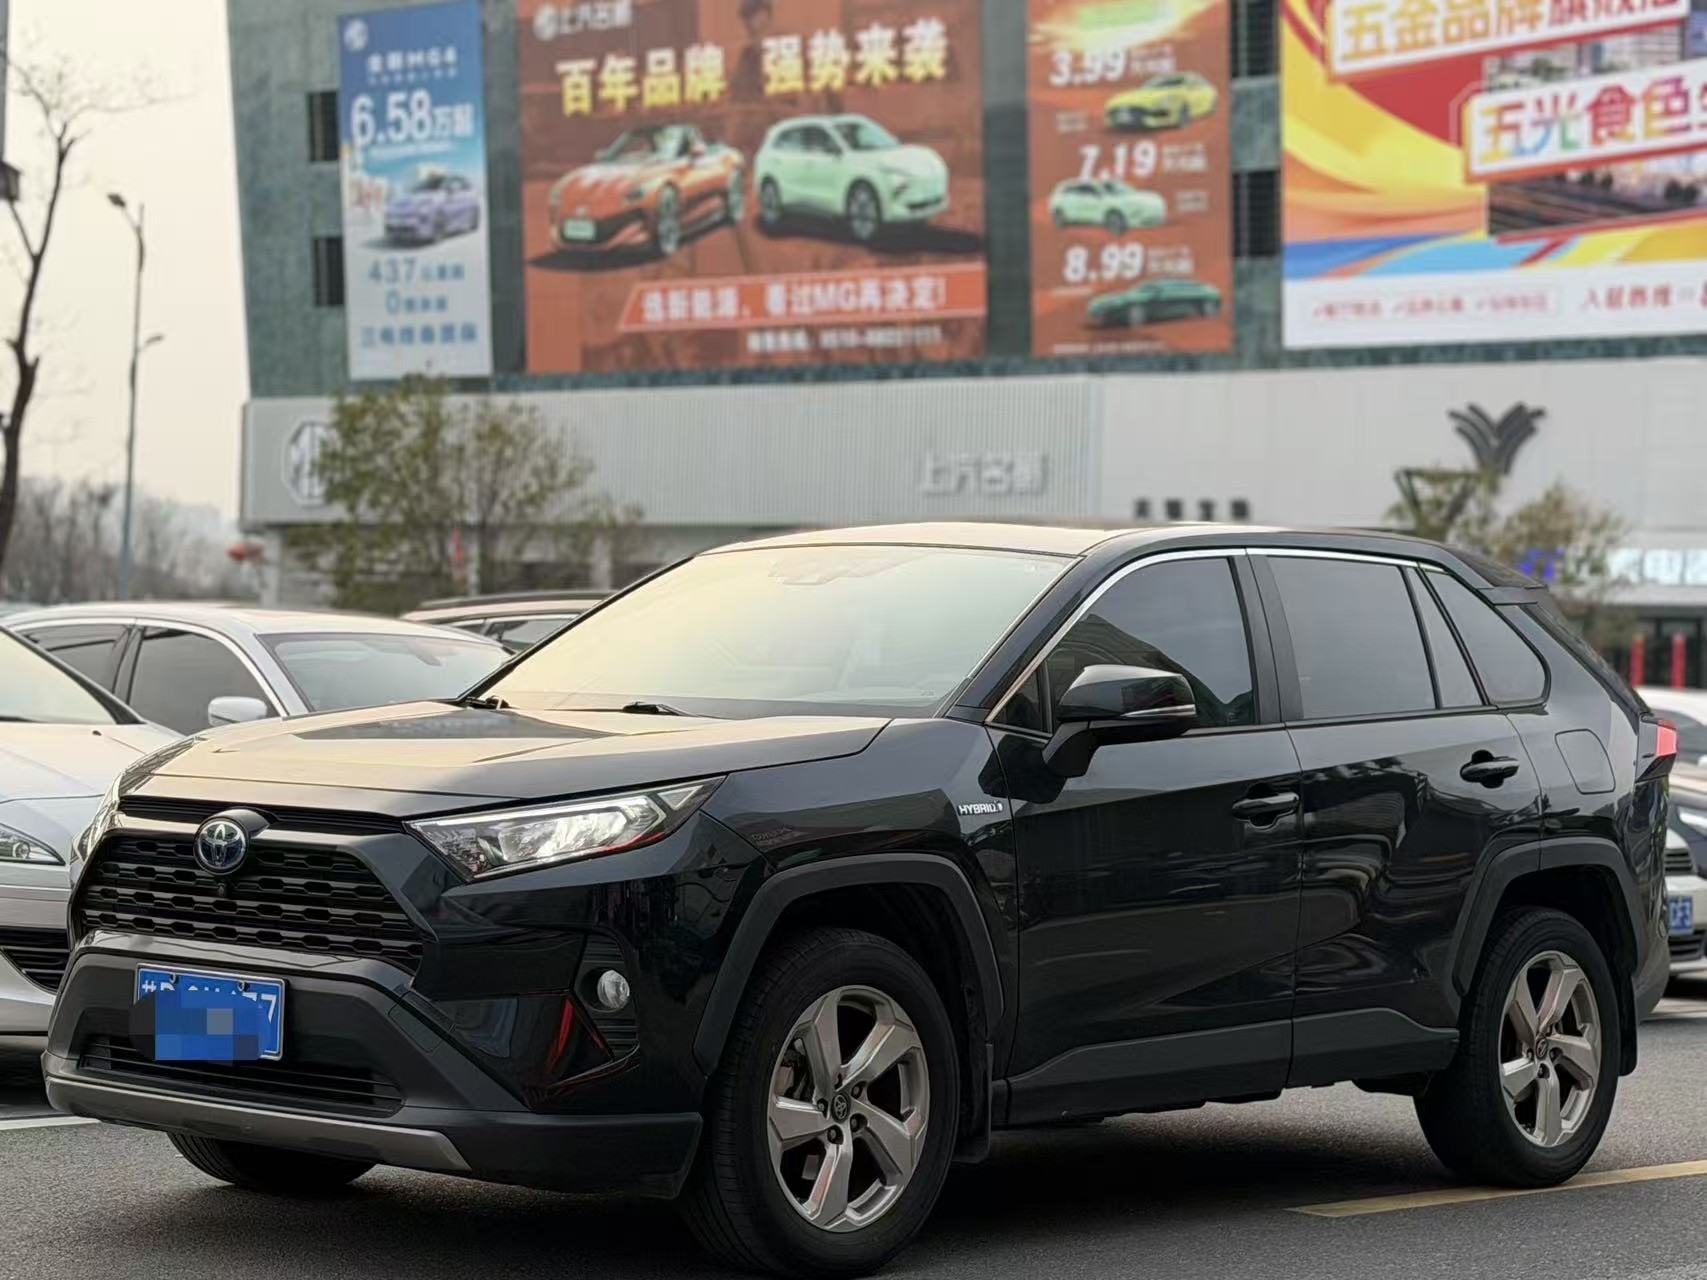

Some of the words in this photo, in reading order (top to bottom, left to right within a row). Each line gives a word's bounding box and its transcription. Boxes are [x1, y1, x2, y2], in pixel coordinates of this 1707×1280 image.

[1341, 0, 1682, 61] 五金品牌旗
[555, 42, 727, 117] 百年品牌
[762, 16, 947, 96] 强势来袭
[1049, 47, 1127, 87] 3.99
[1079, 139, 1157, 182] 7.19
[1064, 241, 1144, 284] 8.99
[959, 802, 998, 815] HYBRID
